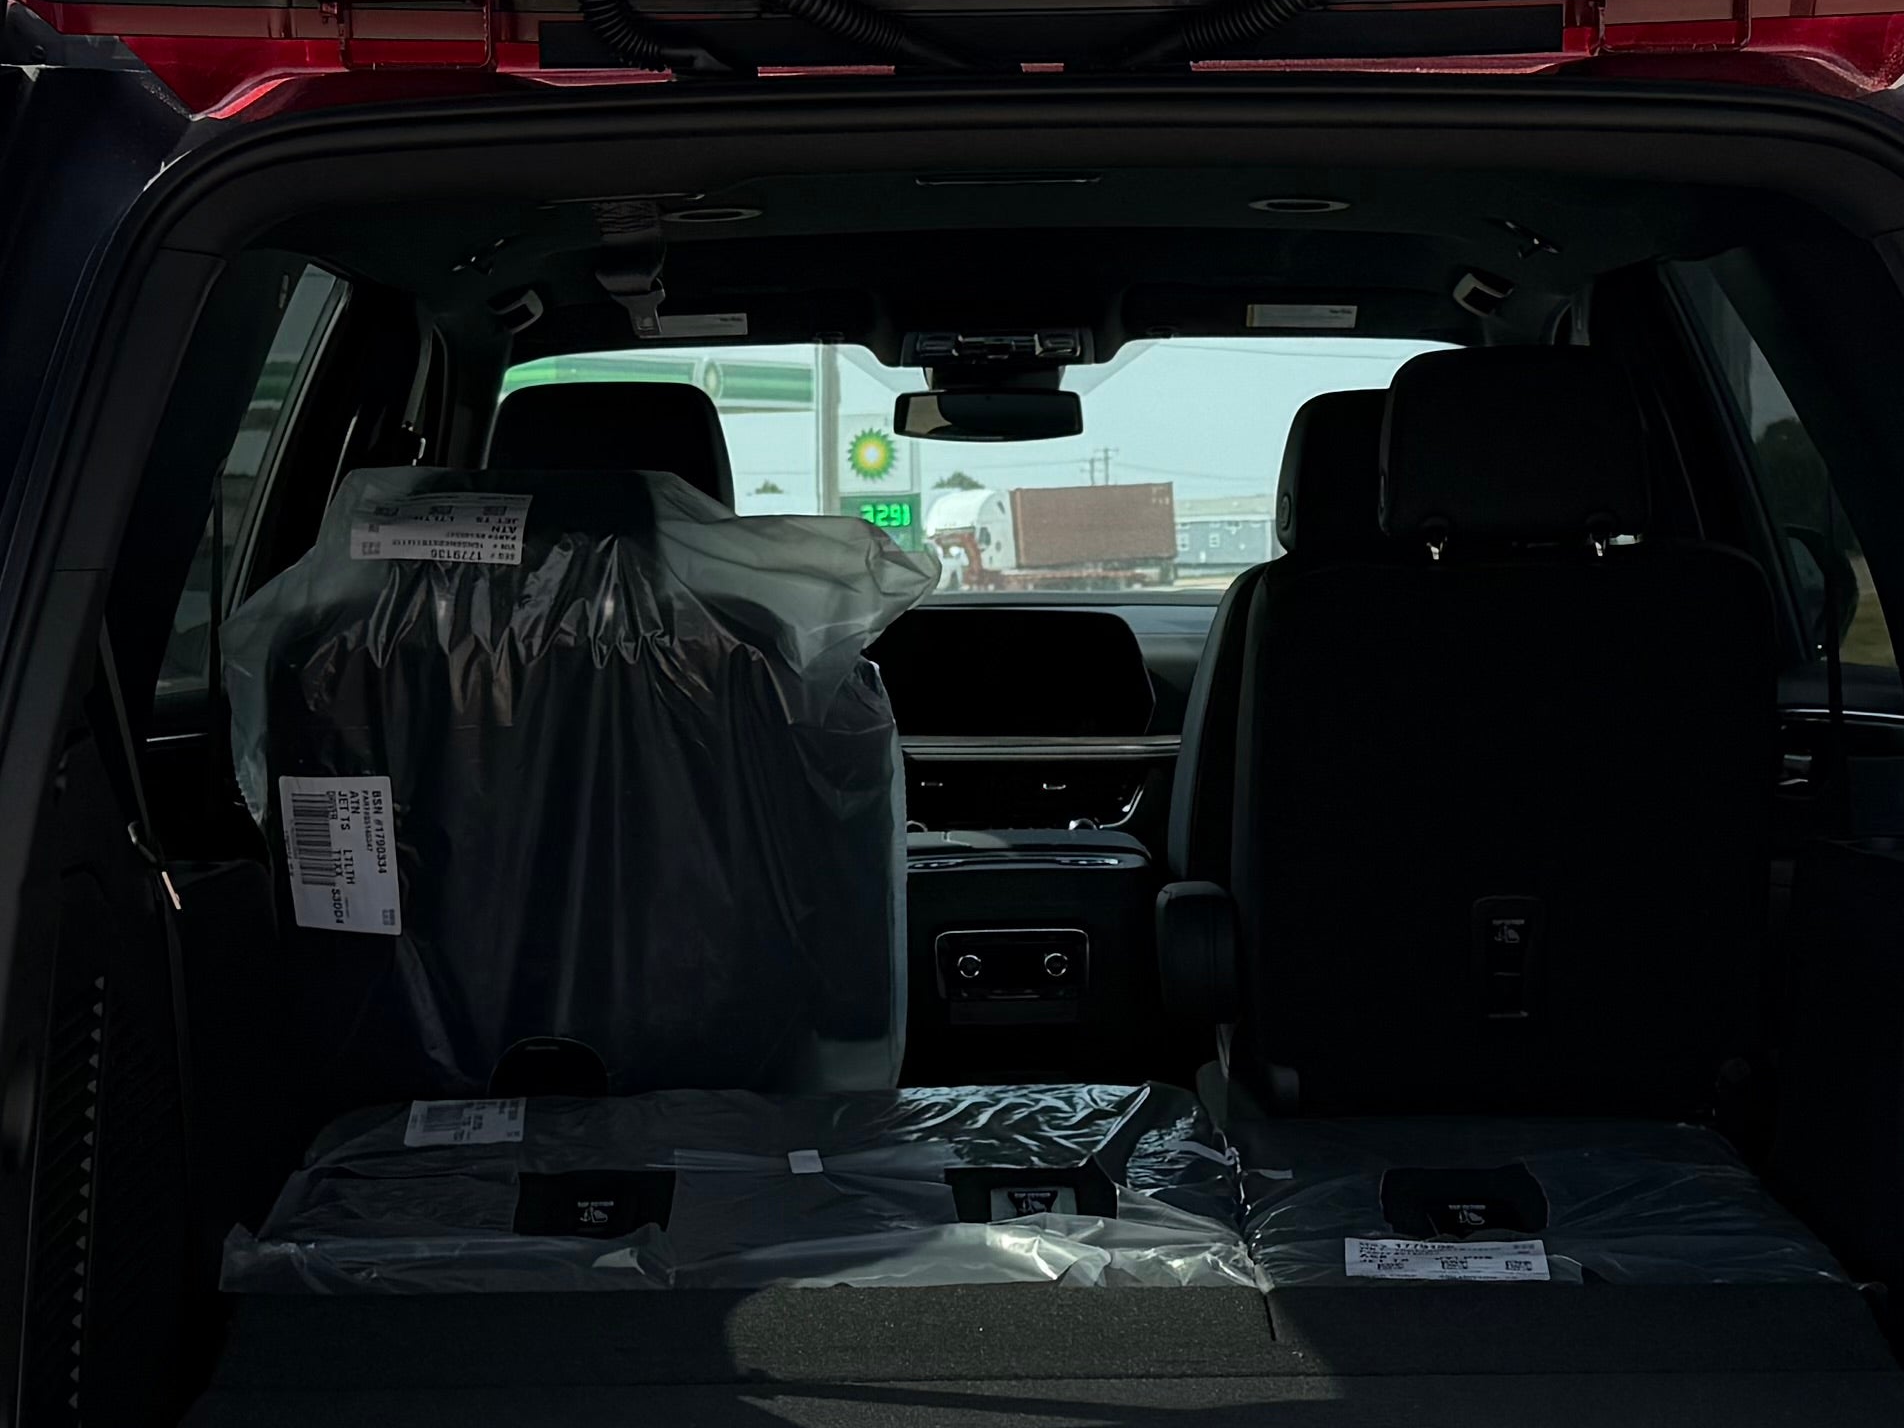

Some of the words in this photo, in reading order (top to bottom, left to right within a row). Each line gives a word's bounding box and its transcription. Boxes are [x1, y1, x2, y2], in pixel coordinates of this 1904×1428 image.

[338, 790, 349, 811] JET
[349, 790, 360, 815] ATN
[372, 790, 383, 815] BSN
[340, 816, 351, 831] TS
[343, 849, 356, 885] LTLTH
